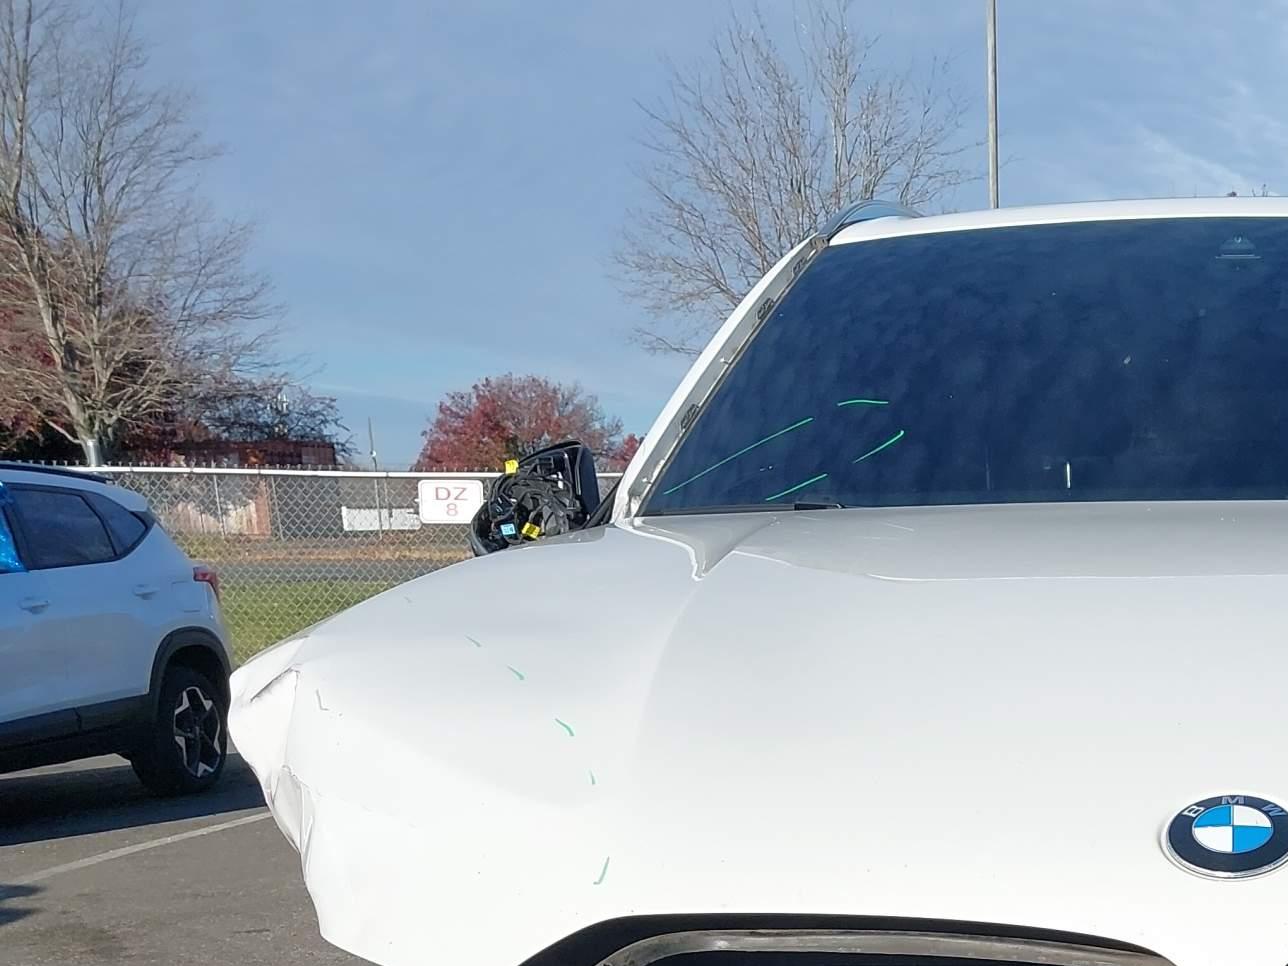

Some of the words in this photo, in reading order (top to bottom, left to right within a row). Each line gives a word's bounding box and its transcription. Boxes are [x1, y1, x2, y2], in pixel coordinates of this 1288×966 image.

[434, 486, 469, 501] DZ
[446, 502, 458, 516] 8
[1181, 796, 1287, 818] BMW
